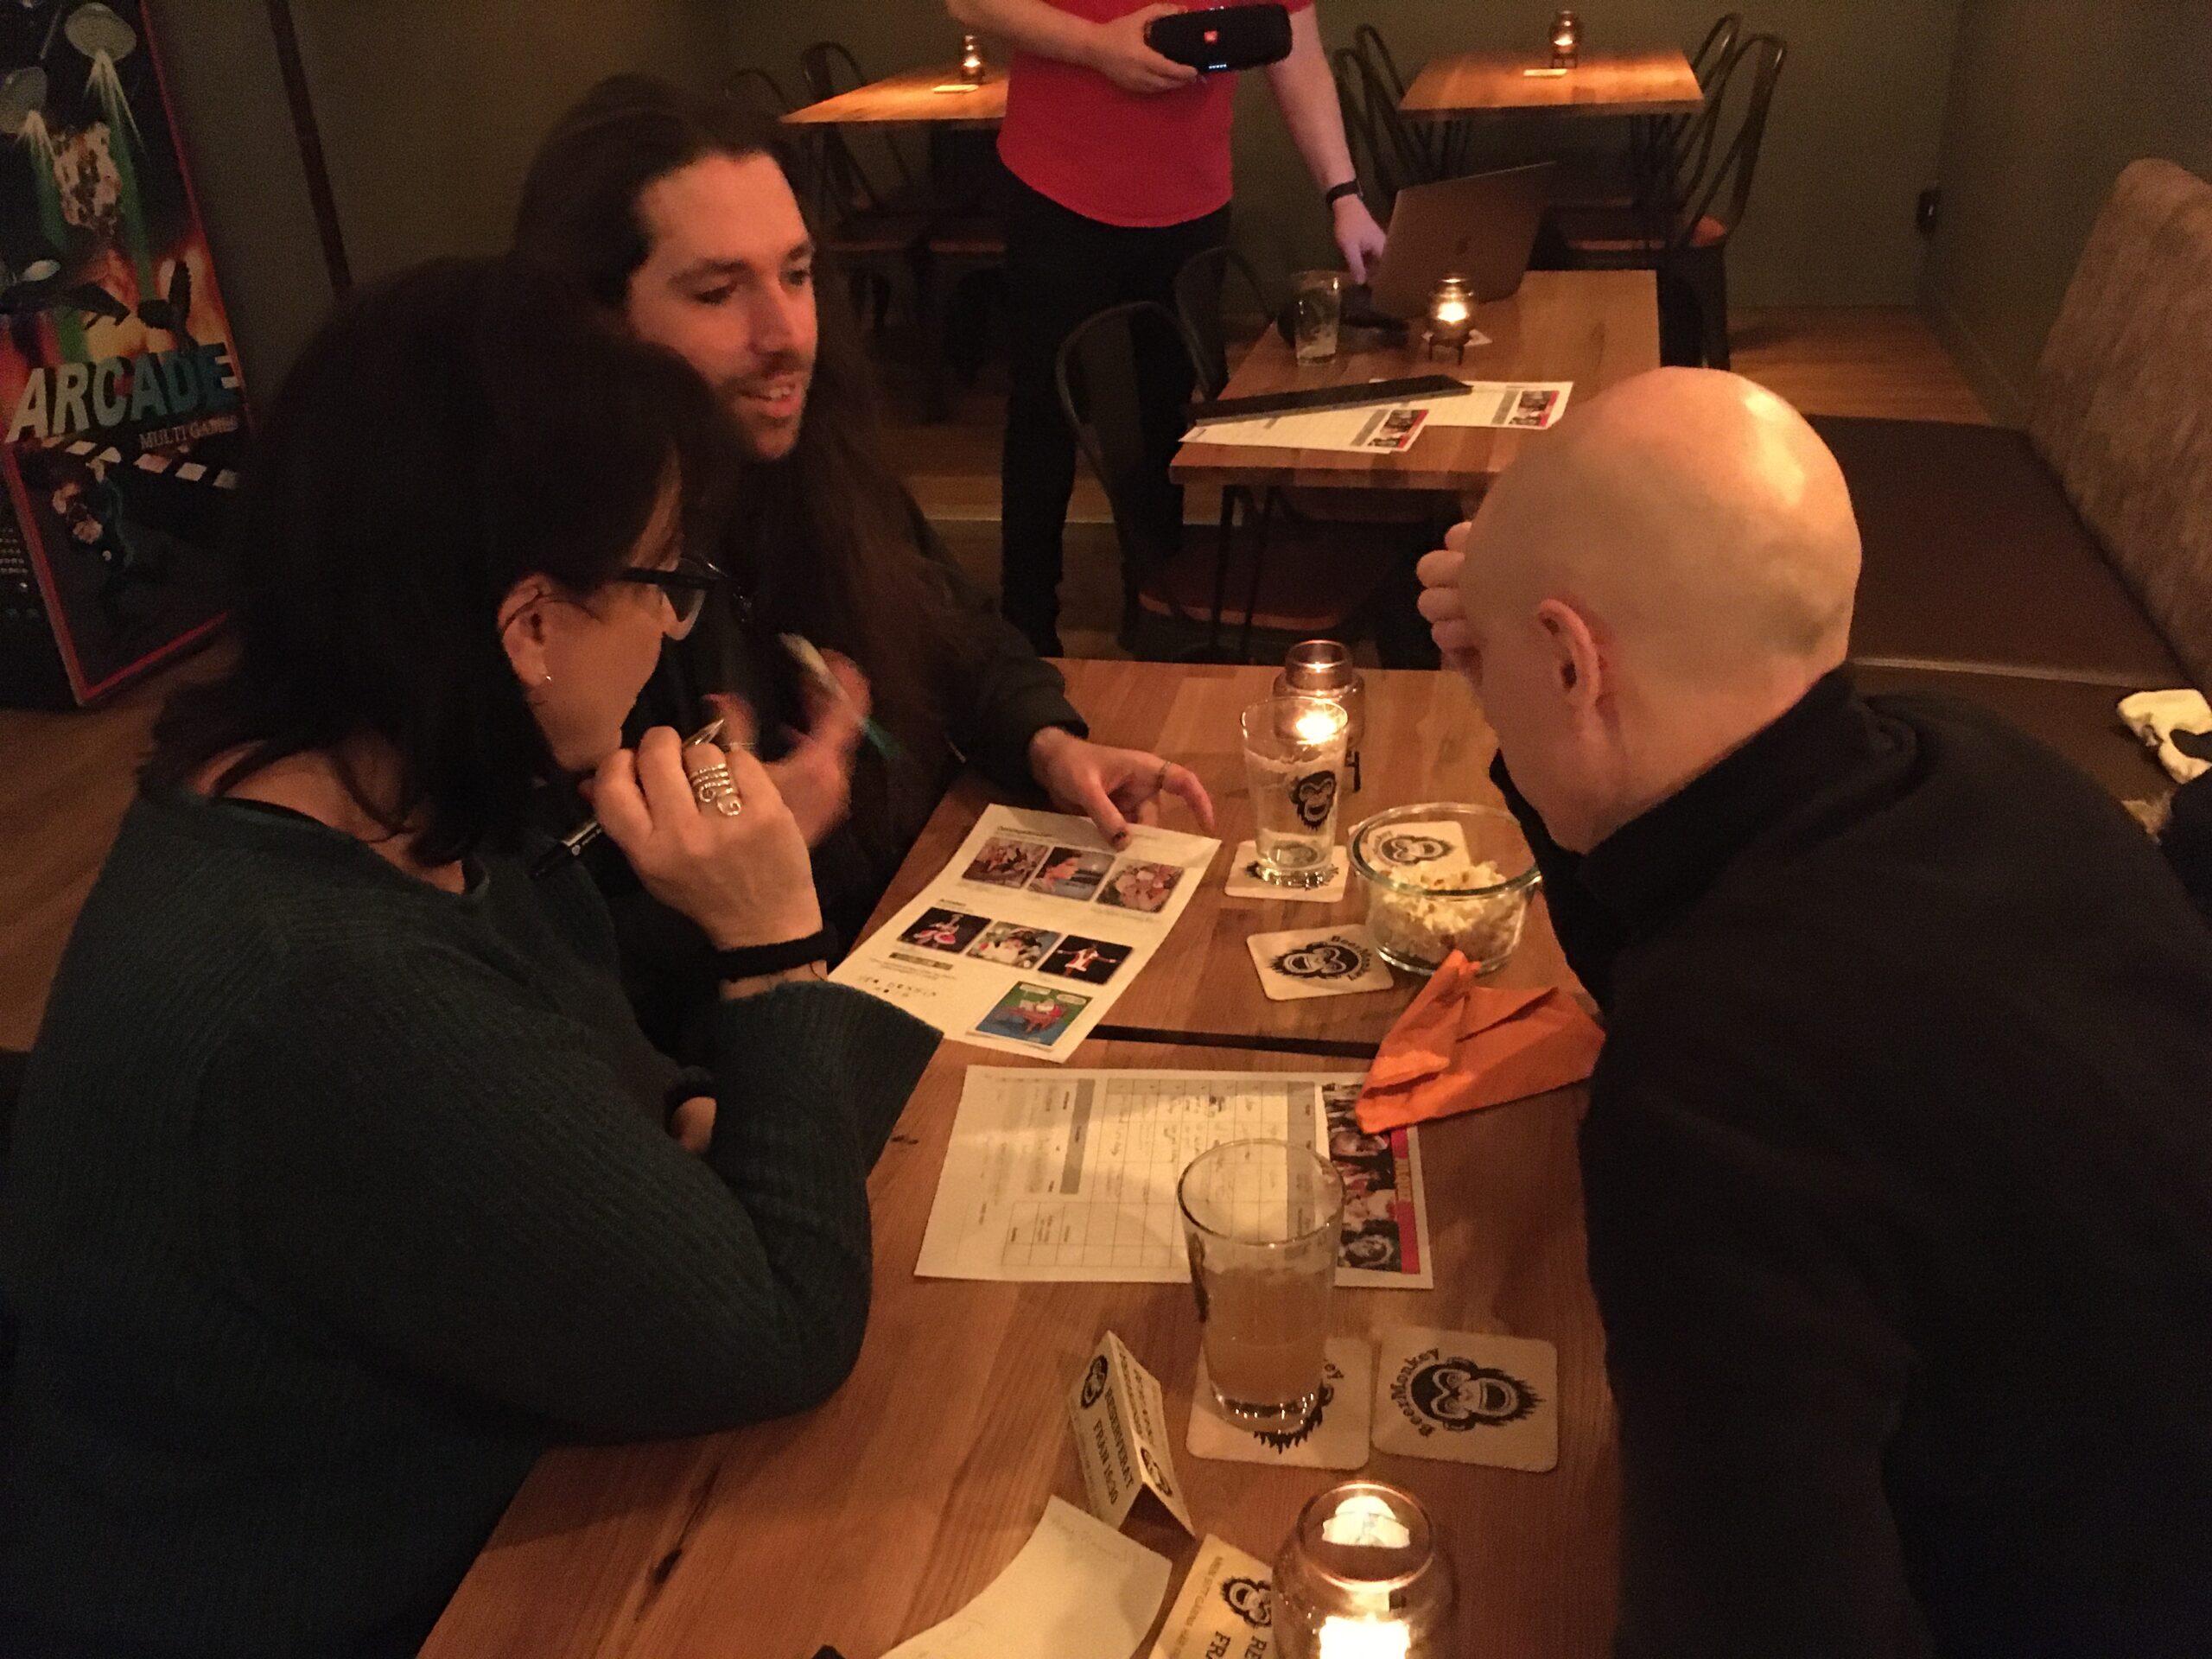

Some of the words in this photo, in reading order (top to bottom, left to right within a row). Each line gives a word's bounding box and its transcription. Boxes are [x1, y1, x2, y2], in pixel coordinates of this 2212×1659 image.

[4, 343, 242, 443] ARCADE
[138, 425, 188, 450] MULTI
[1104, 1386, 1135, 1490] RESERVERAT
